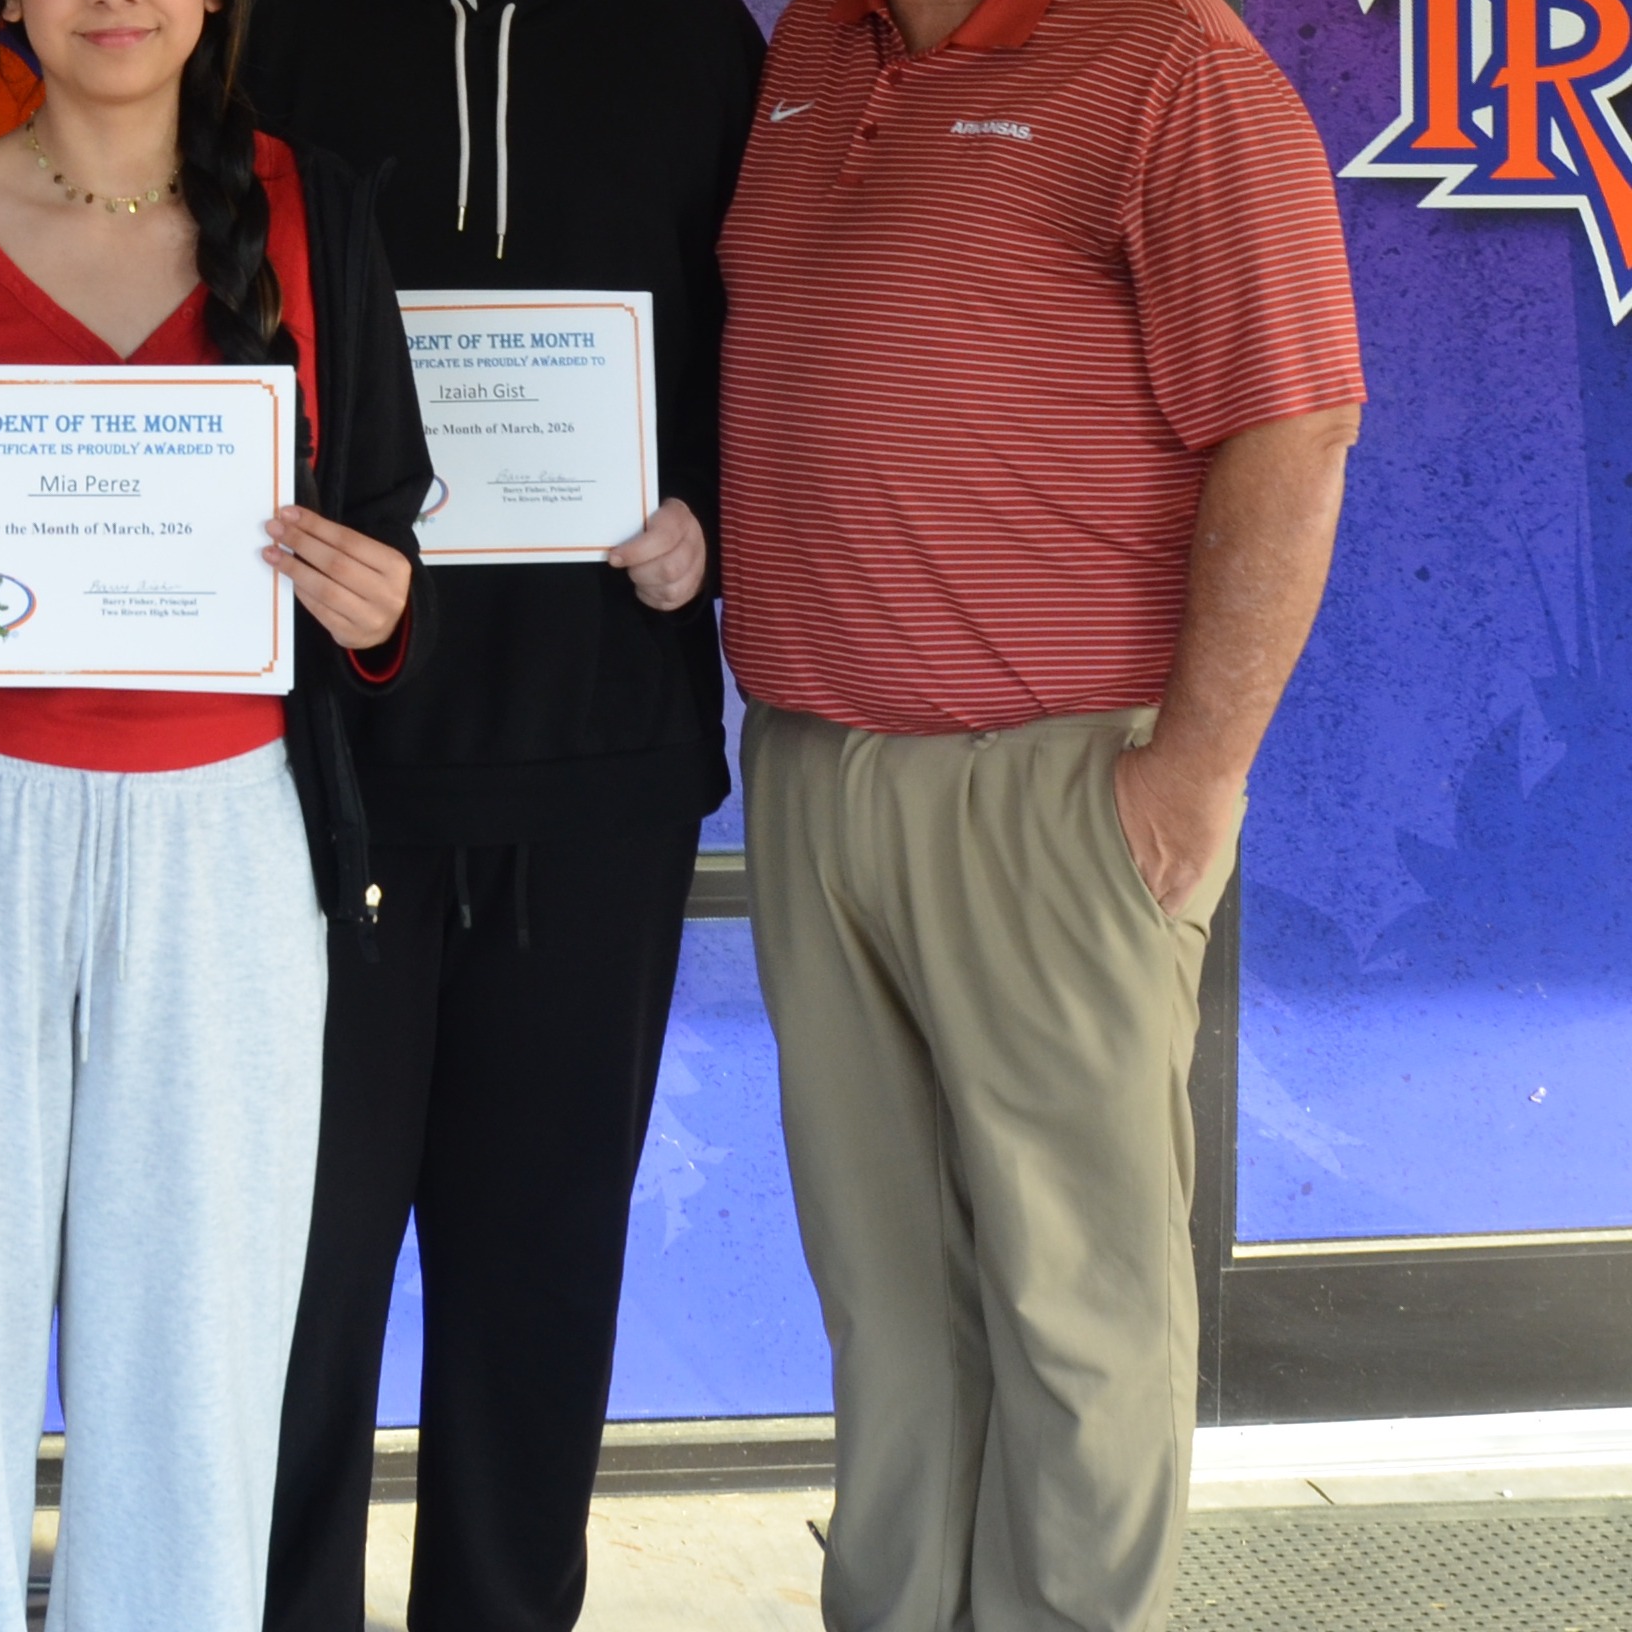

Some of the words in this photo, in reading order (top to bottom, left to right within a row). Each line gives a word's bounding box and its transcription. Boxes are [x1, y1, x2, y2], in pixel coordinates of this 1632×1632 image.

[407, 334, 453, 351] DENT
[457, 333, 482, 350] OF
[486, 332, 525, 349] THE
[530, 332, 595, 349] MONTH
[412, 357, 461, 370] IFICATE
[462, 357, 474, 368] IS
[476, 356, 528, 368] PROUDLY
[531, 356, 589, 367] AWARDED
[590, 355, 606, 366] TO
[439, 383, 488, 400] Izaiah
[492, 383, 526, 400] Gist
[54, 414, 86, 433] OF
[89, 414, 138, 433] THE
[142, 414, 223, 433] MONTH
[424, 424, 439, 435] he
[441, 423, 482, 435] Month
[484, 423, 498, 434] of
[500, 422, 544, 434] March,
[547, 421, 575, 434] 2026
[59, 443, 74, 455] IS
[76, 443, 141, 456] PROUDLY
[142, 443, 214, 455] AWARDED
[216, 443, 235, 455] TO
[39, 474, 78, 493] Mia
[85, 474, 140, 494] Perez
[4, 522, 28, 535] the
[31, 522, 80, 535] Month
[83, 522, 100, 535] of
[101, 522, 155, 535] March,
[158, 521, 193, 535] 2026
